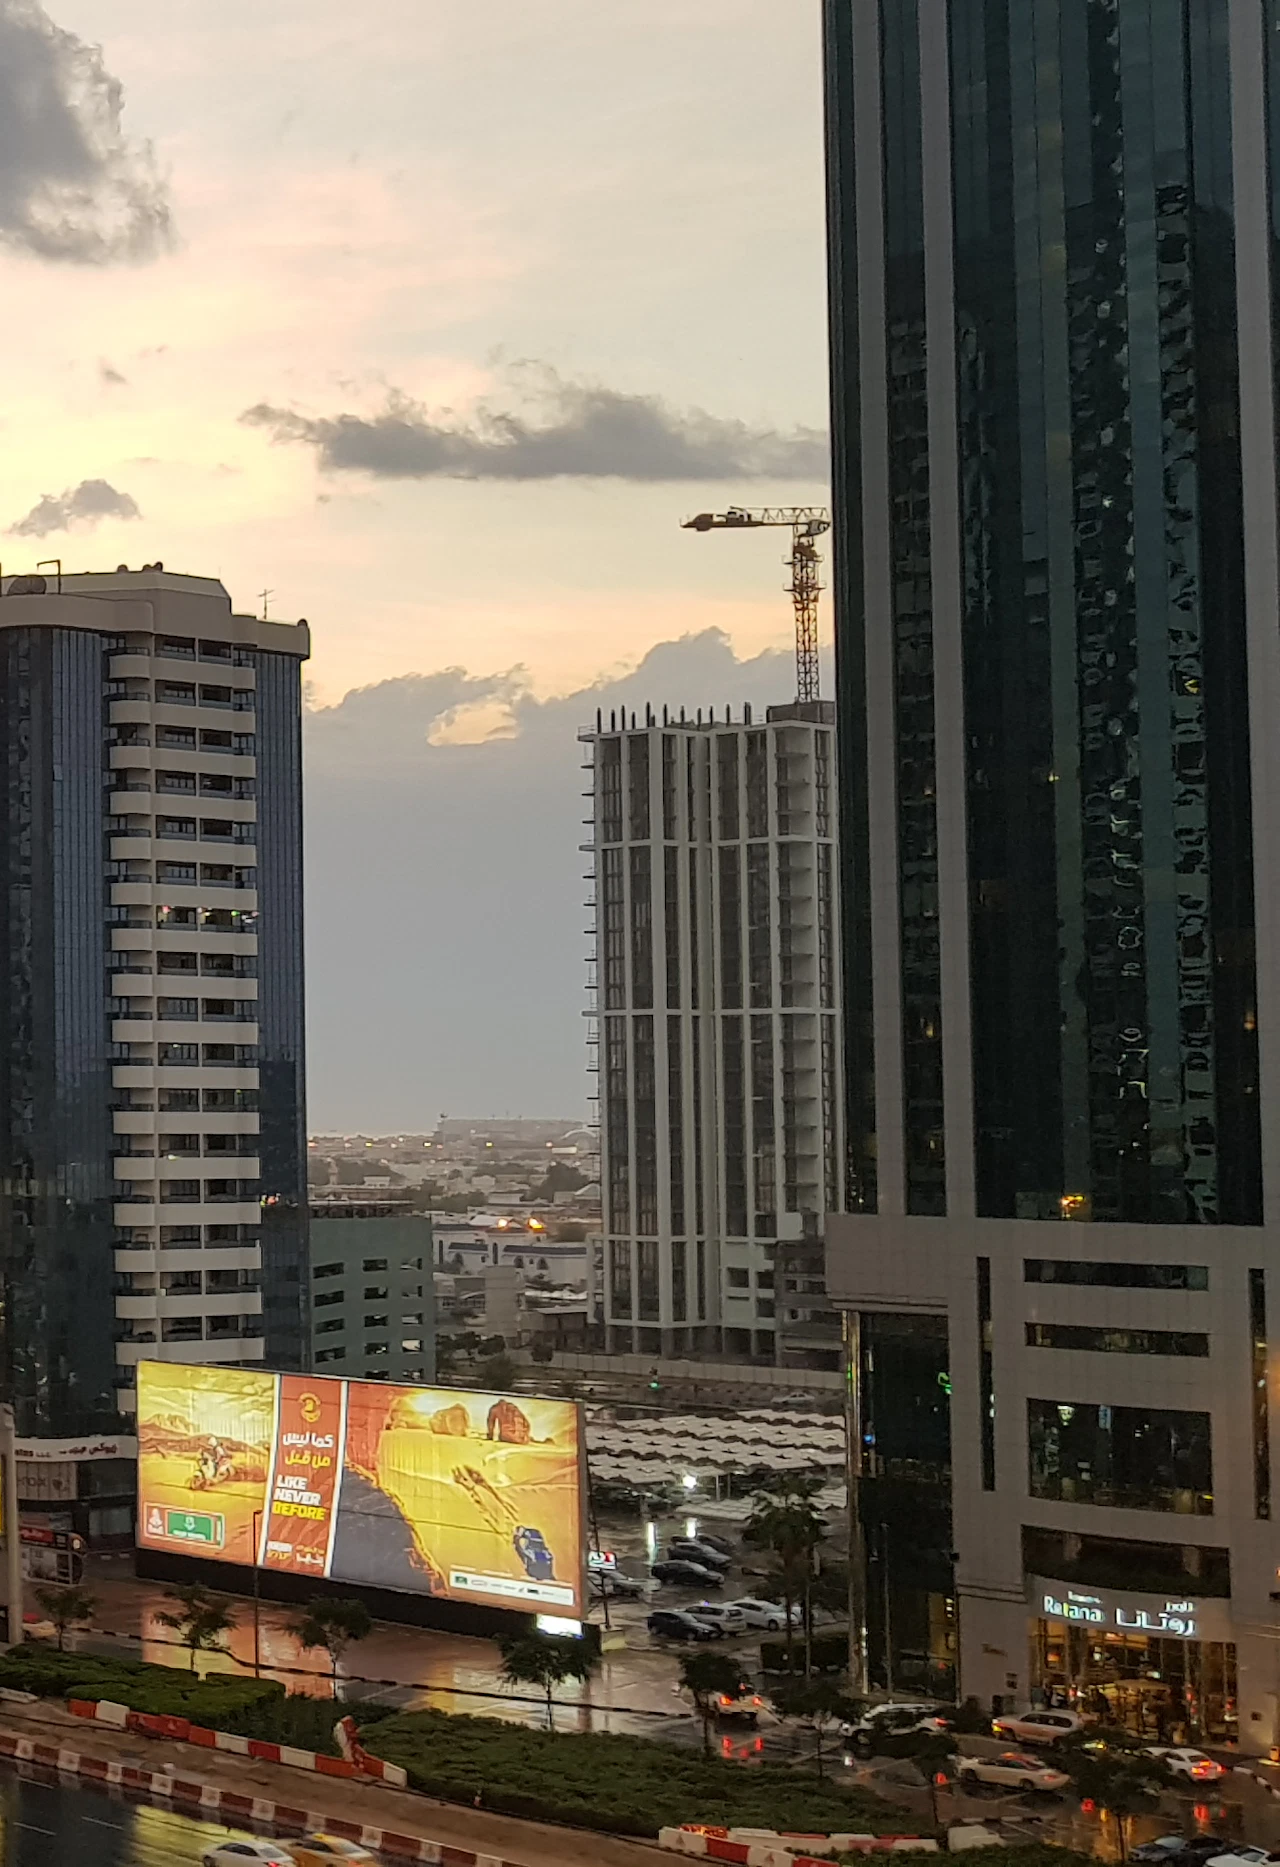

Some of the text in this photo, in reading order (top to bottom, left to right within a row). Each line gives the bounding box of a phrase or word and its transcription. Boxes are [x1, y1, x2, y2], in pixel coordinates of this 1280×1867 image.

[283, 1431, 334, 1449] كما ليس
[285, 1450, 331, 1469] من قبل
[277, 1474, 308, 1491] LIKE
[274, 1488, 321, 1507] NEVER
[272, 1502, 326, 1521] BEFORE
[1115, 1607, 1196, 1637] روتانا
